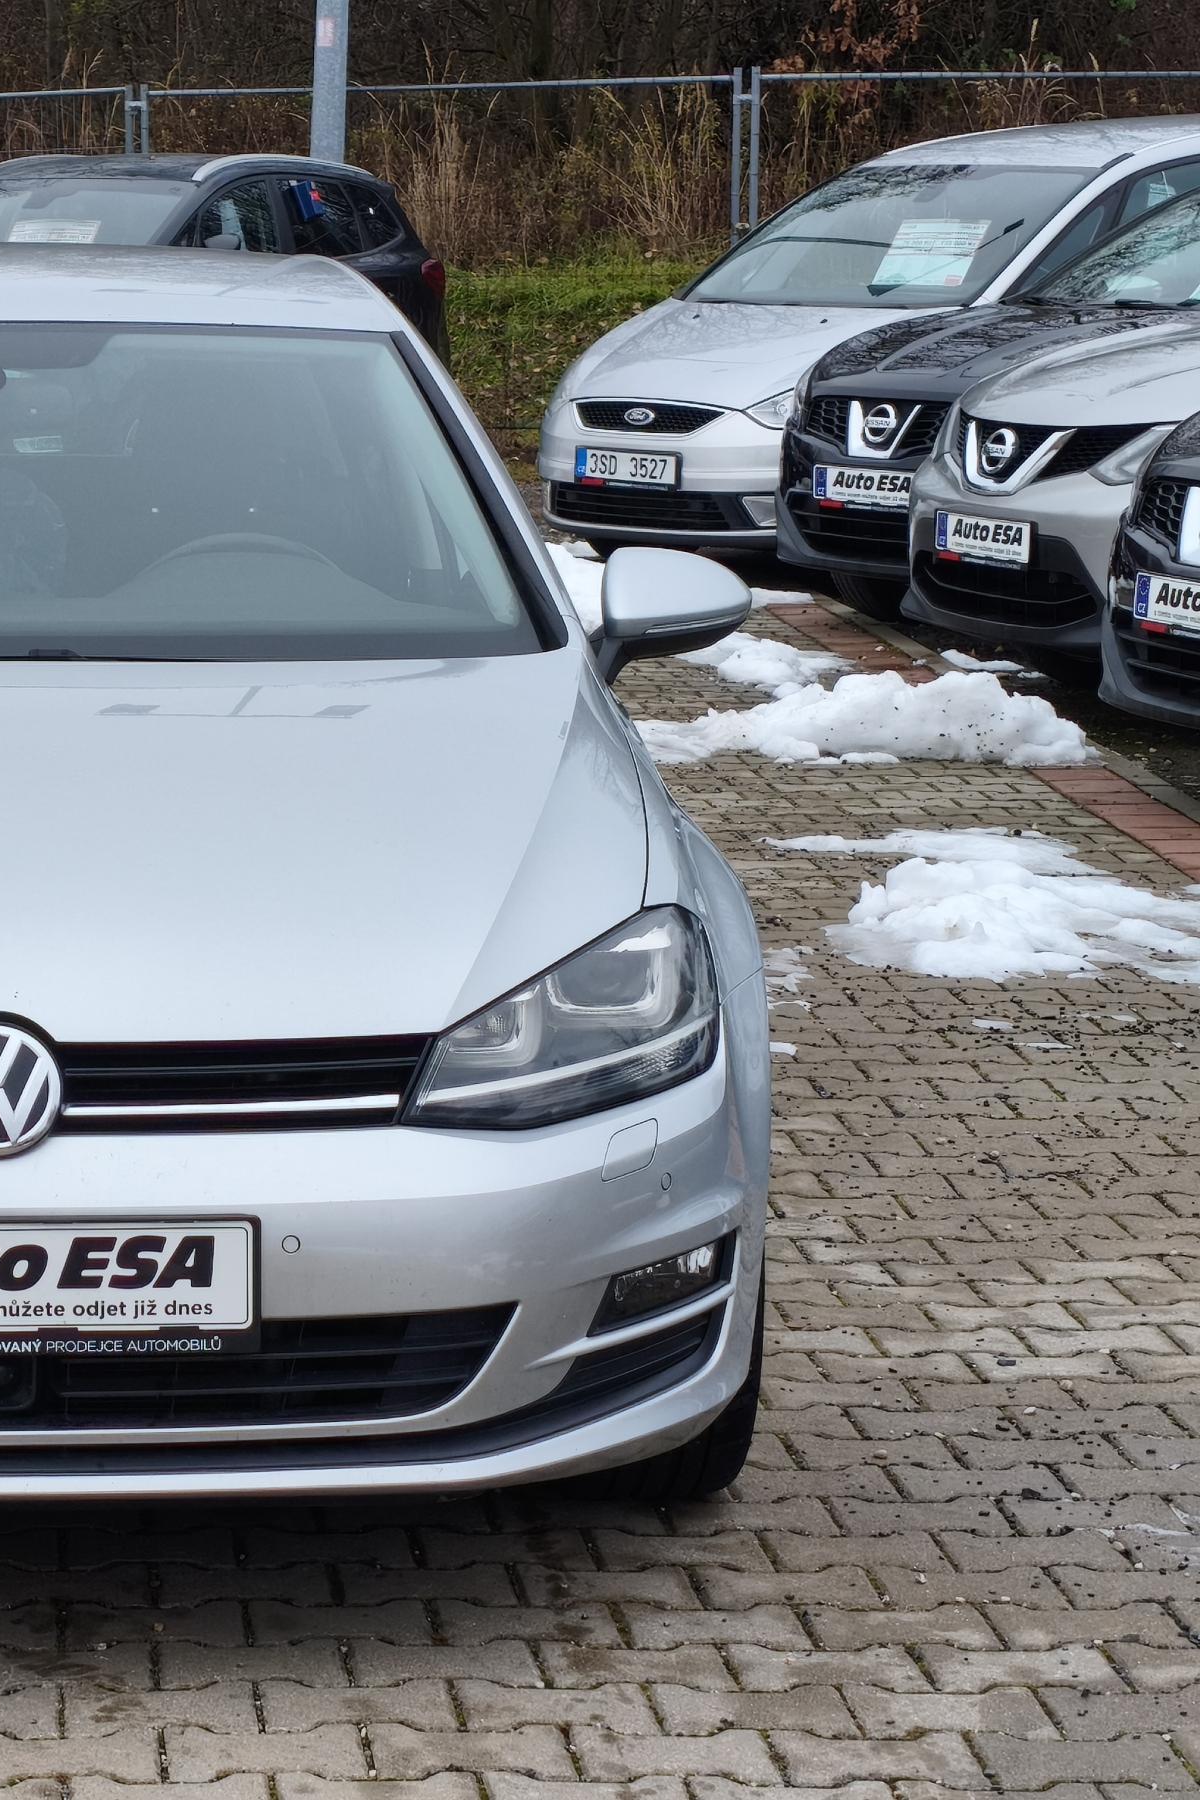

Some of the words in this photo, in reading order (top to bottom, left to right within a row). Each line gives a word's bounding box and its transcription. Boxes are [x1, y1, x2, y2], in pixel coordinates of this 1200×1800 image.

[589, 453, 618, 476] 3SD
[629, 457, 668, 480] 3527
[832, 471, 875, 491] Auto
[876, 474, 911, 494] ESA
[952, 518, 990, 541] Auto
[991, 524, 1023, 547] ESA
[1137, 602, 1146, 613] CZ
[56, 1235, 215, 1290] ESA
[72, 1300, 127, 1319] odjet
[133, 1300, 157, 1319] již
[164, 1300, 214, 1317] dnes
[46, 1339, 123, 1353] PRODEJCE
[127, 1335, 222, 1352] AUTOMOBILŮ
